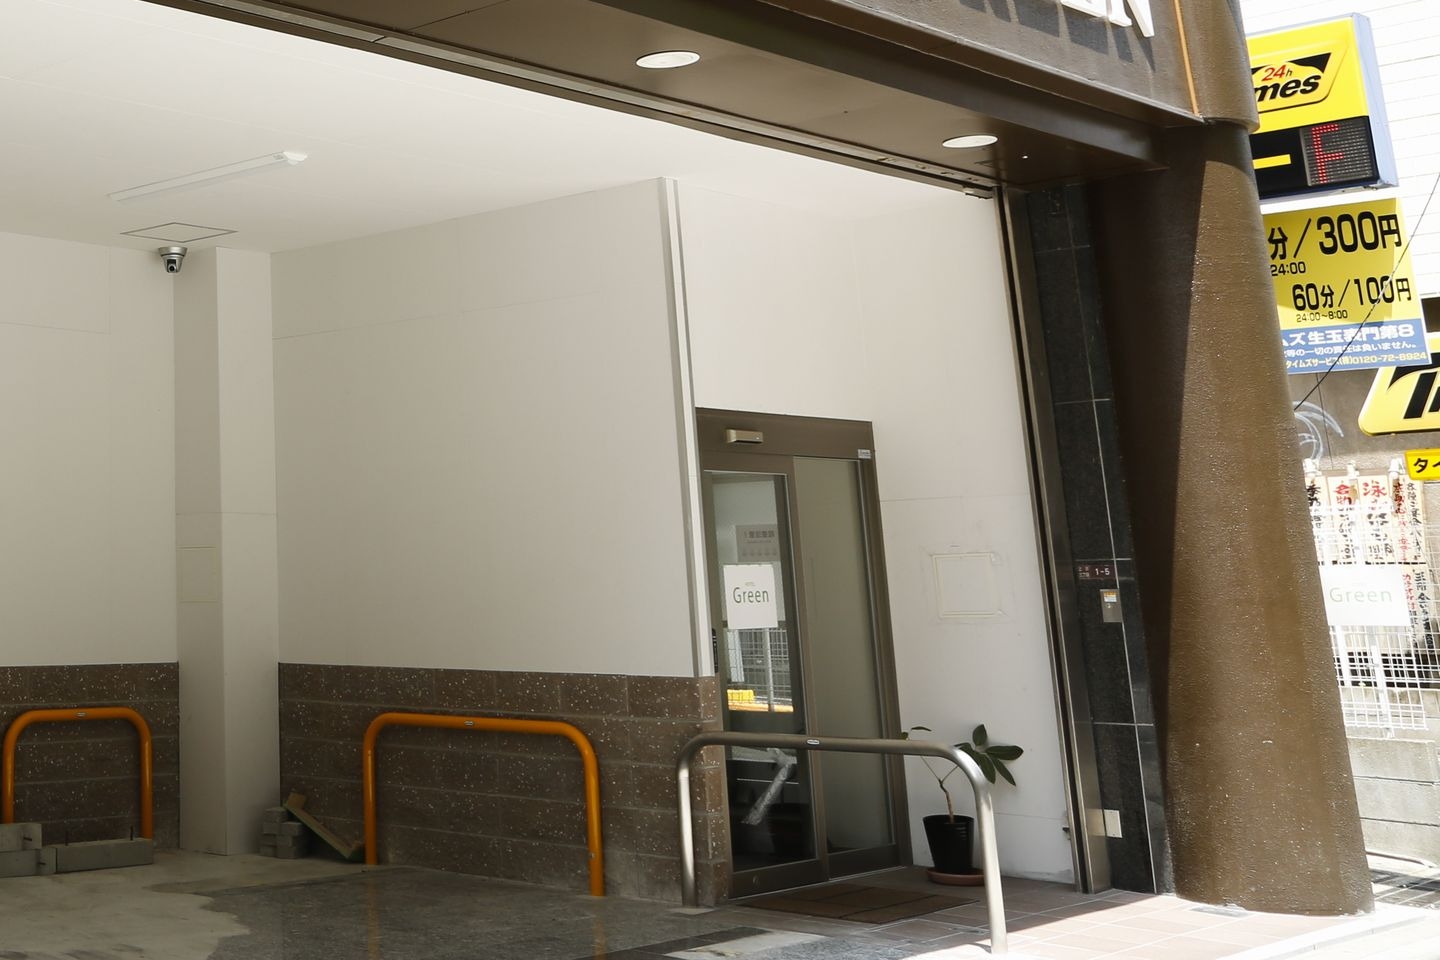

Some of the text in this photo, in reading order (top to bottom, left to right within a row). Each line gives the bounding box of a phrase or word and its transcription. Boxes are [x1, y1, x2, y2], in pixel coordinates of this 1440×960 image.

[1261, 64, 1293, 82] 24h
[732, 586, 770, 604] Green
[1329, 586, 1393, 604] Green
